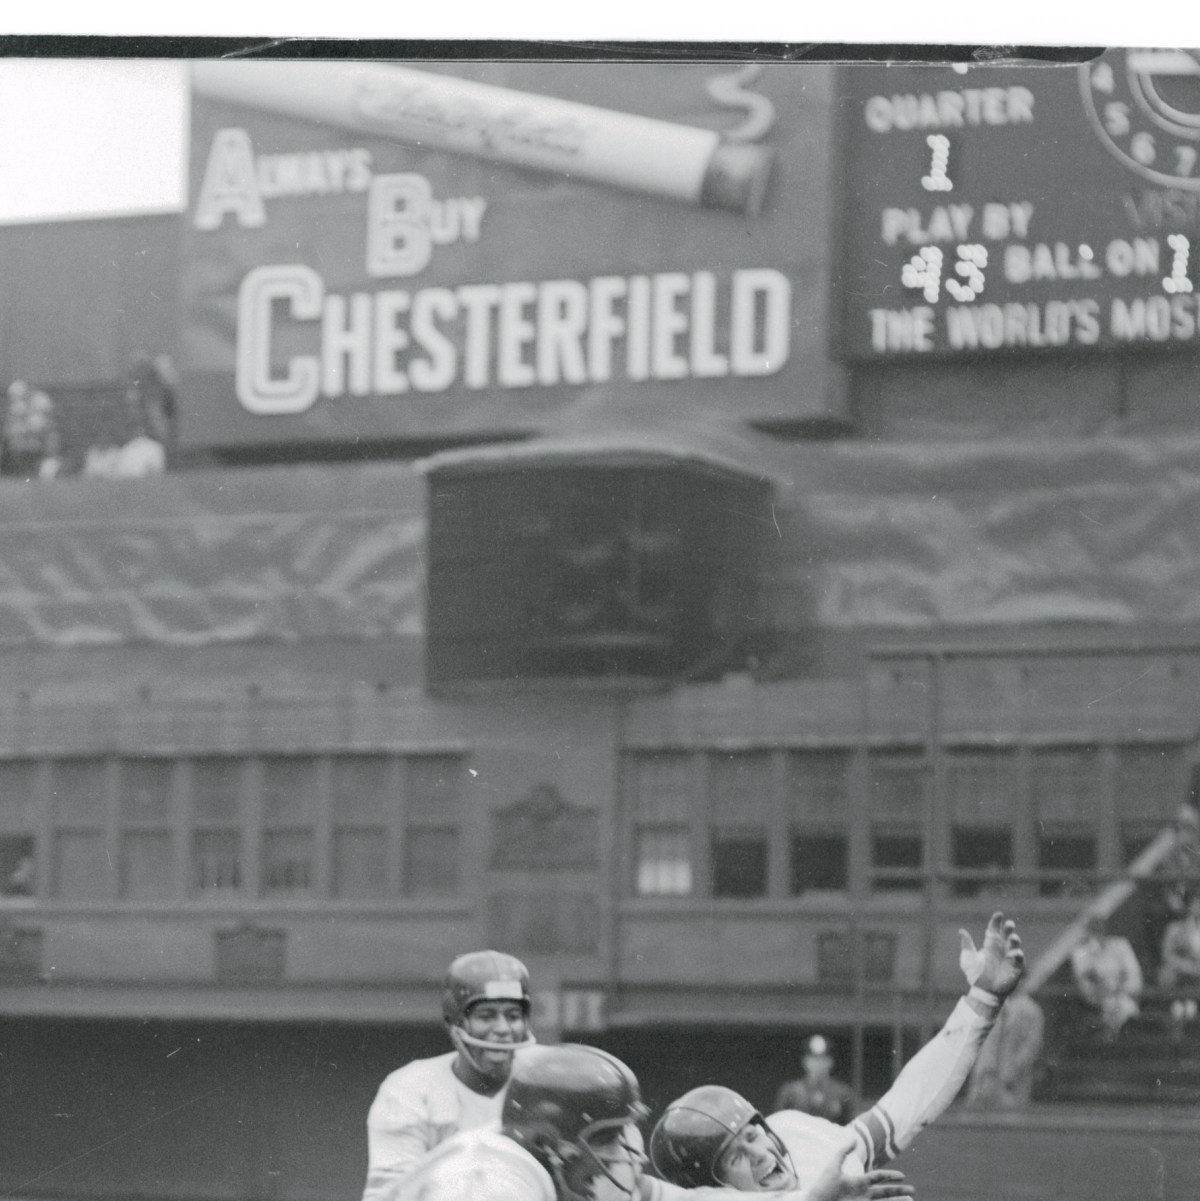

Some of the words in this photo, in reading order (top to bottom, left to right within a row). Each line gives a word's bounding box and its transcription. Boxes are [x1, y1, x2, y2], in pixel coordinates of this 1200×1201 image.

[866, 88, 1034, 132] QUARTER
[921, 134, 953, 191] 1
[366, 172, 487, 276] BUY
[882, 203, 974, 246] PLAY
[982, 202, 1034, 239] BY
[236, 265, 792, 415] CHESTERFIELD
[870, 306, 934, 351] THE
[947, 299, 1100, 350] WORLD'S
[1111, 293, 1200, 342] MOS
